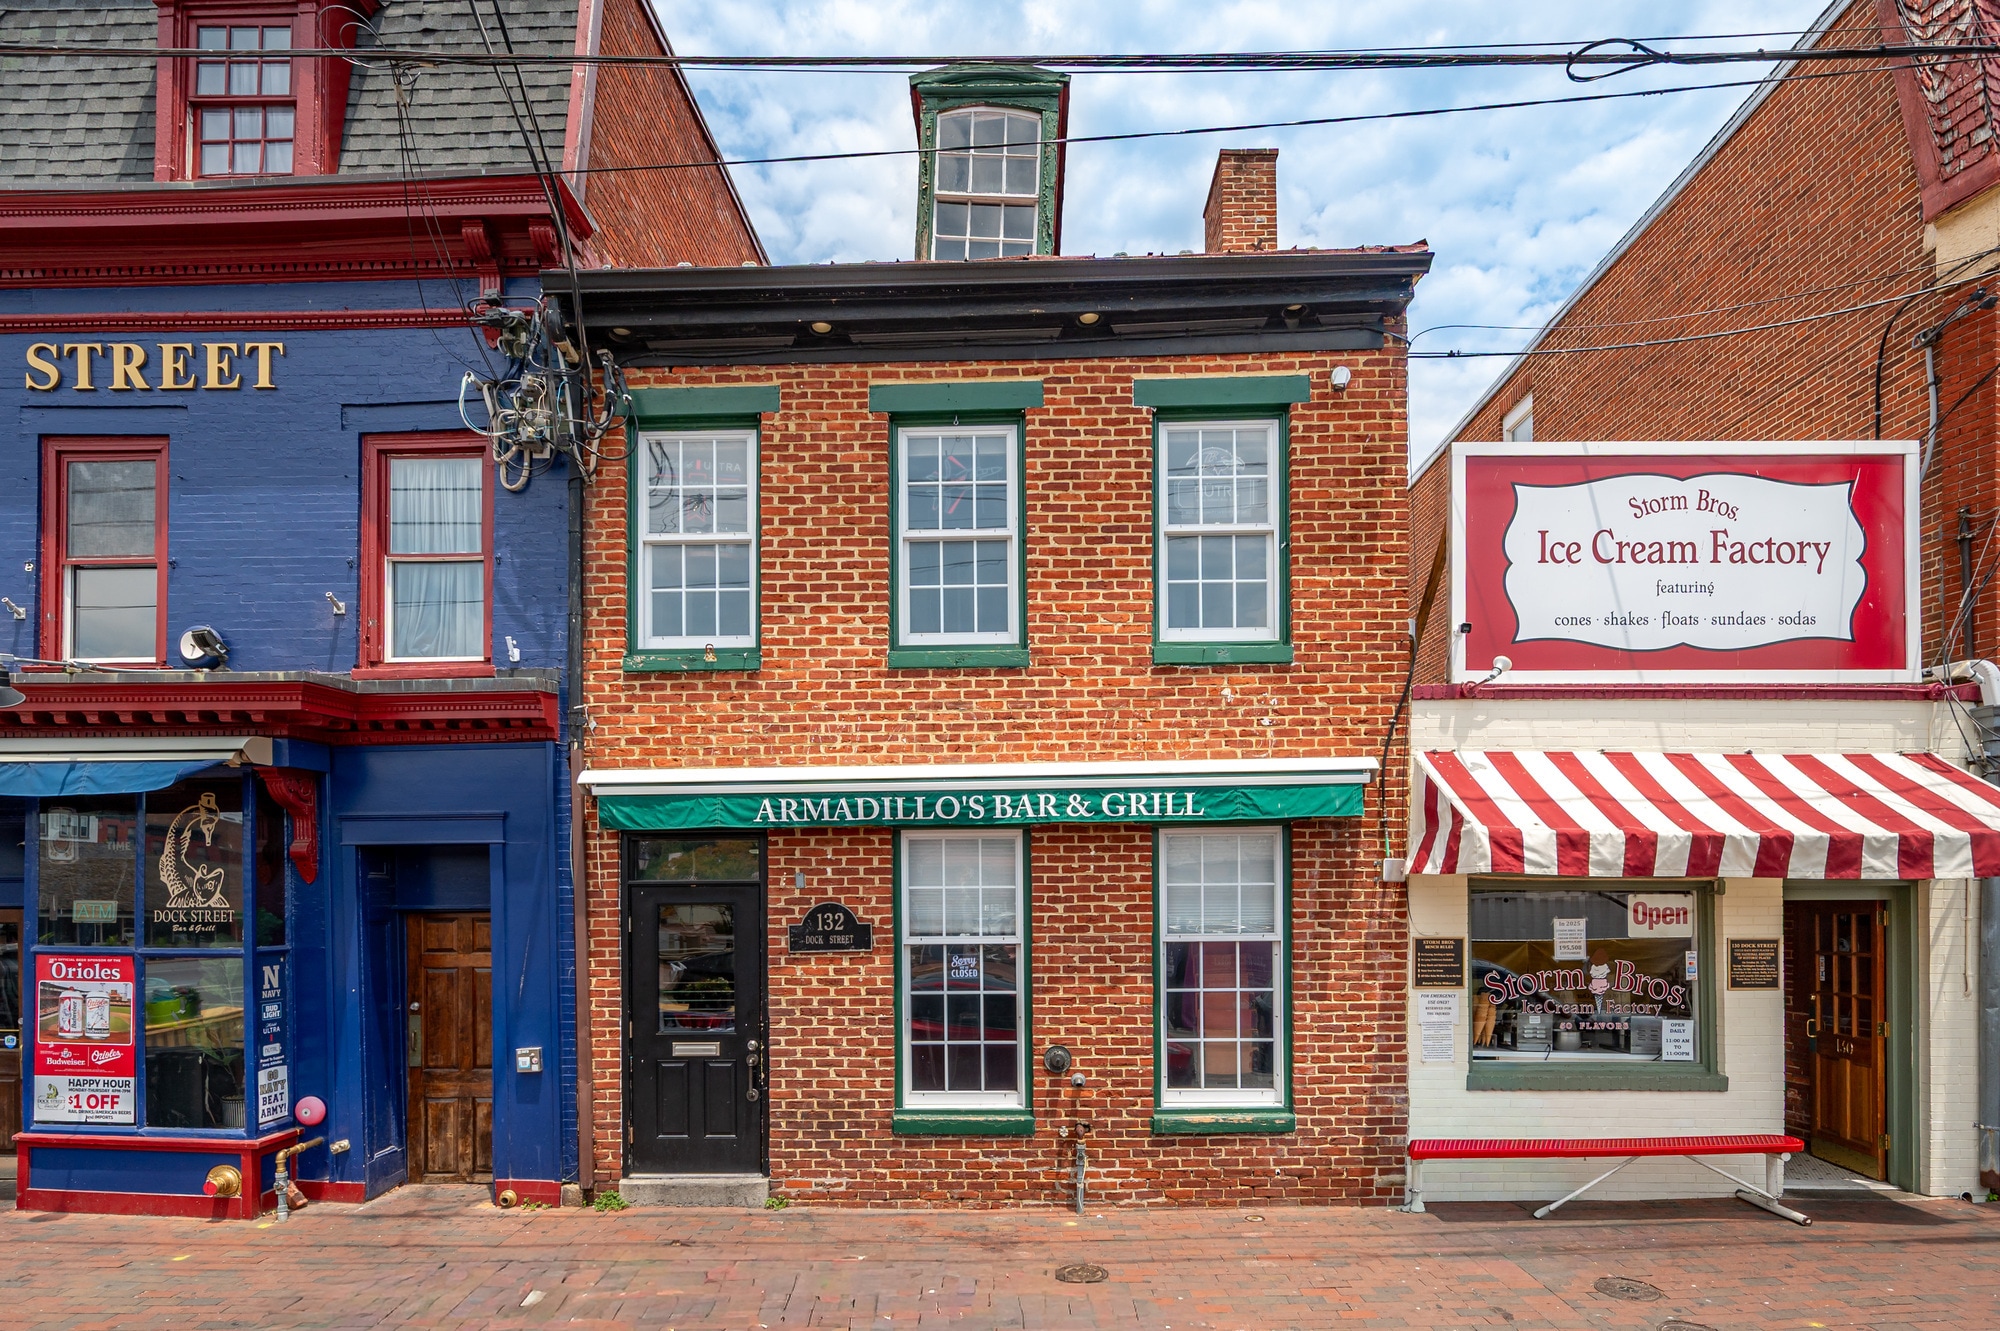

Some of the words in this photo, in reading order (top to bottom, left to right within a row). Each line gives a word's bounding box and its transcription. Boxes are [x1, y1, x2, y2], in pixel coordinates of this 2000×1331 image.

[26, 342, 285, 391] STREET
[703, 463, 741, 472] UTRA
[1628, 495, 1688, 519] Storm
[1696, 489, 1739, 521] Bros.
[1537, 530, 1582, 564] Ice
[1592, 528, 1699, 564] Cream
[1710, 528, 1831, 575] Factory
[1656, 579, 1714, 597] featuring
[1554, 616, 1592, 626] cones
[1603, 611, 1649, 626] shakes
[1662, 611, 1699, 629] floats
[1711, 611, 1766, 626] sundaes
[1778, 611, 1816, 626] sodas
[753, 796, 985, 822] ARMADILLO'S
[992, 793, 1060, 818] BAR
[1066, 793, 1095, 818] &
[1101, 792, 1204, 817] GRILL
[107, 842, 132, 851] TIME
[77, 905, 113, 919] ATM
[154, 910, 188, 922] DOCK
[190, 910, 235, 922] STREET
[1633, 901, 1688, 930] Open
[195, 924, 216, 933] Grill
[817, 912, 845, 931] 132
[805, 935, 824, 944] DOCK
[829, 934, 854, 943] STREET
[951, 955, 978, 967] Sorry
[51, 962, 121, 980] Orioles
[262, 965, 280, 990] N
[951, 969, 978, 978] CLOSED
[1484, 969, 1587, 1005] Storm
[1612, 960, 1685, 1009] Bros.
[262, 989, 281, 999] NAVY
[263, 1010, 281, 1019] LIGHT
[1606, 999, 1662, 1018] Factory
[262, 1026, 280, 1035] ULTRA
[1579, 1022, 1629, 1030] FLAVORS
[46, 1057, 86, 1066] Budweiser
[91, 1049, 123, 1064] Orioles
[267, 1069, 278, 1081] GO
[68, 1079, 101, 1088] HAPPY
[103, 1080, 131, 1089] HOUR
[260, 1079, 286, 1095] NAVY
[68, 1094, 82, 1109] $1
[86, 1094, 120, 1109] OFF
[262, 1092, 284, 1106] BEAT
[261, 1103, 286, 1118] ARMY!
